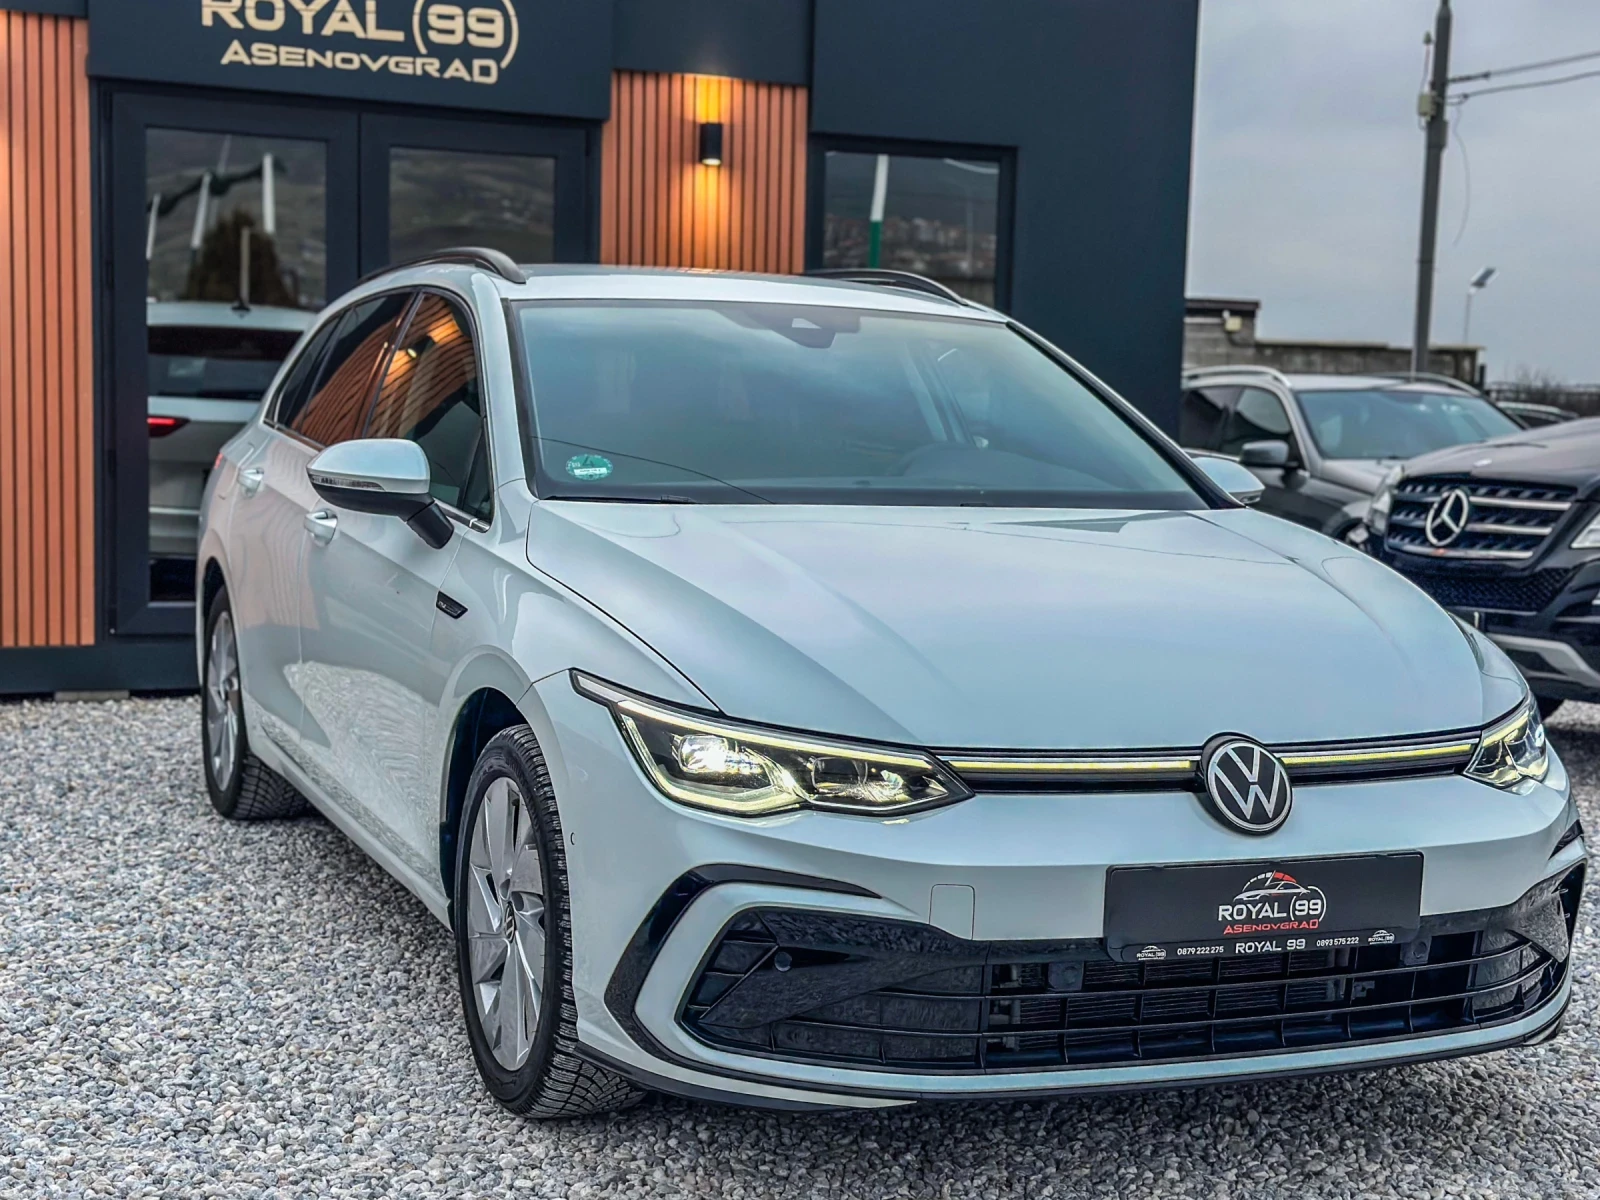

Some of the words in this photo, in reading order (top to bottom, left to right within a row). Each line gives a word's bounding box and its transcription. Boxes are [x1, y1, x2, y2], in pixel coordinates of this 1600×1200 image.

[201, 0, 405, 42] ROYAL
[220, 39, 499, 85] ASENOVGRAD
[1218, 902, 1287, 921] ROYAL
[1223, 919, 1319, 935] ASENOVGRAD
[1177, 947, 1196, 956] 0879
[1196, 946, 1210, 954] 222
[1210, 945, 1225, 953] 275
[1235, 940, 1282, 954] ROYAL
[1286, 938, 1306, 950] 99
[1316, 939, 1333, 947] 0893
